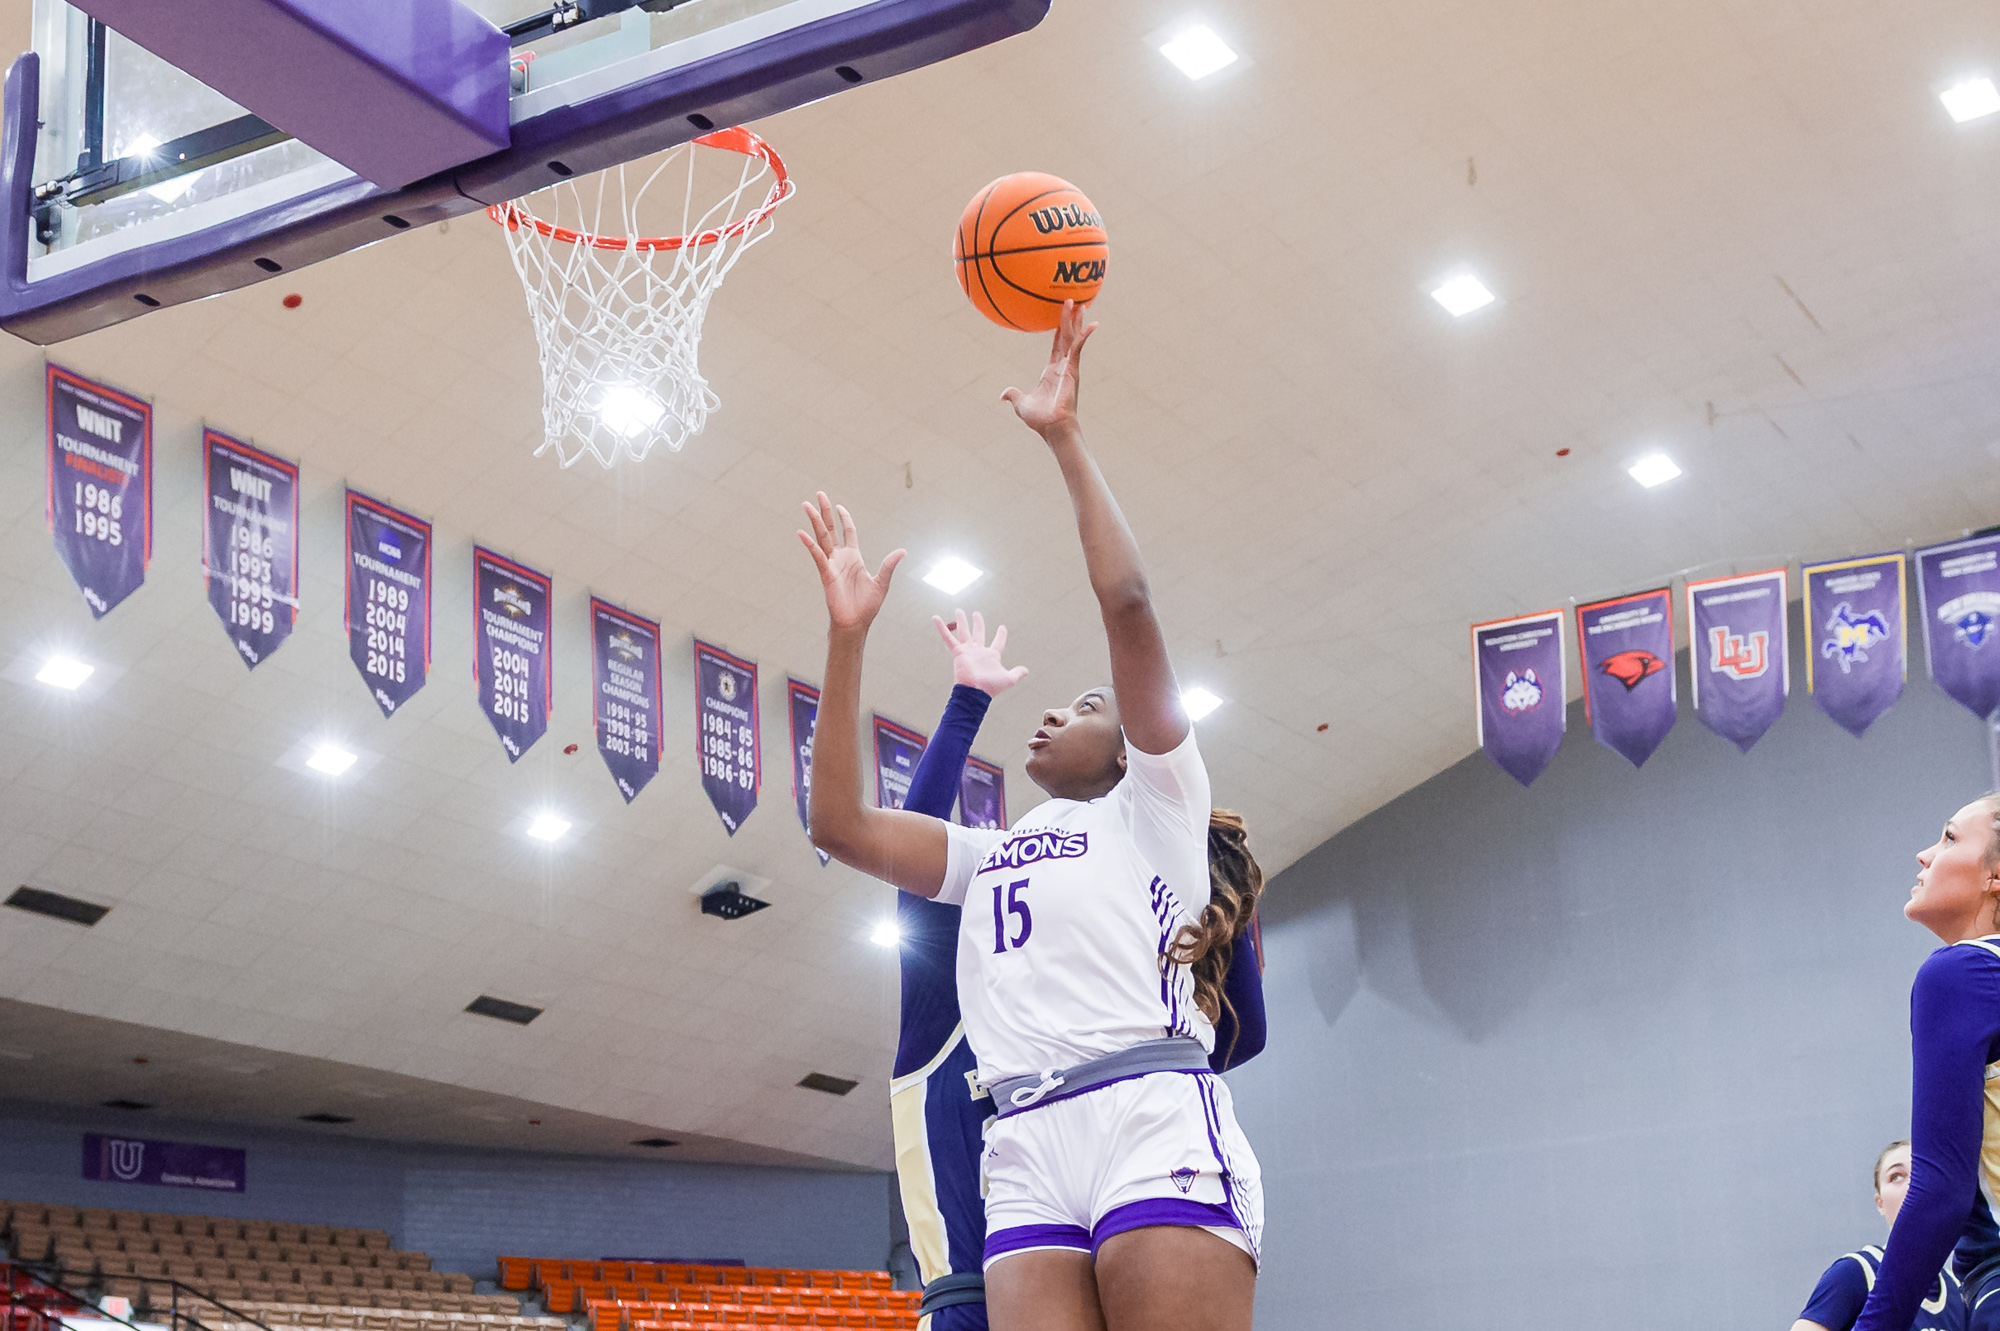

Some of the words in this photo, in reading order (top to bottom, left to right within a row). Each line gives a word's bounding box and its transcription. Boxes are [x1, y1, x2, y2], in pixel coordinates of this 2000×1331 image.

[1053, 258, 1106, 283] NCAA
[76, 404, 122, 443] WNIT
[57, 433, 139, 477] TOURNAMENT
[75, 481, 122, 520] 1986
[230, 467, 272, 503] WNIT
[75, 510, 122, 547] 1995
[213, 495, 288, 534] TOURNAMENT
[231, 525, 273, 560] 1986
[231, 551, 272, 584] 1993
[353, 551, 422, 590] TOURNAMENT
[368, 579, 409, 612] 1989
[231, 602, 275, 635] 1999
[366, 602, 407, 637] 2004
[483, 608, 544, 644] TOURNAMENT
[366, 626, 406, 660] 2014
[486, 624, 539, 655] CHAMPIONS
[1709, 626, 1769, 680] LU
[366, 651, 407, 684] 2015
[493, 646, 530, 678] 2004
[608, 659, 645, 684] REGULAR
[494, 671, 529, 701] 2014
[602, 682, 650, 710] CHAMPIONS
[610, 673, 643, 694] SEASON
[493, 694, 530, 724] 2015
[705, 697, 749, 722] CHAMPIONS
[703, 712, 753, 748] 1984-85
[606, 734, 648, 762] 2003-04
[703, 735, 753, 769] 1985-86
[704, 757, 755, 791] 1986-87
[978, 834, 1087, 872] EMONS
[992, 877, 1032, 954] 15
[111, 1139, 145, 1180] U
